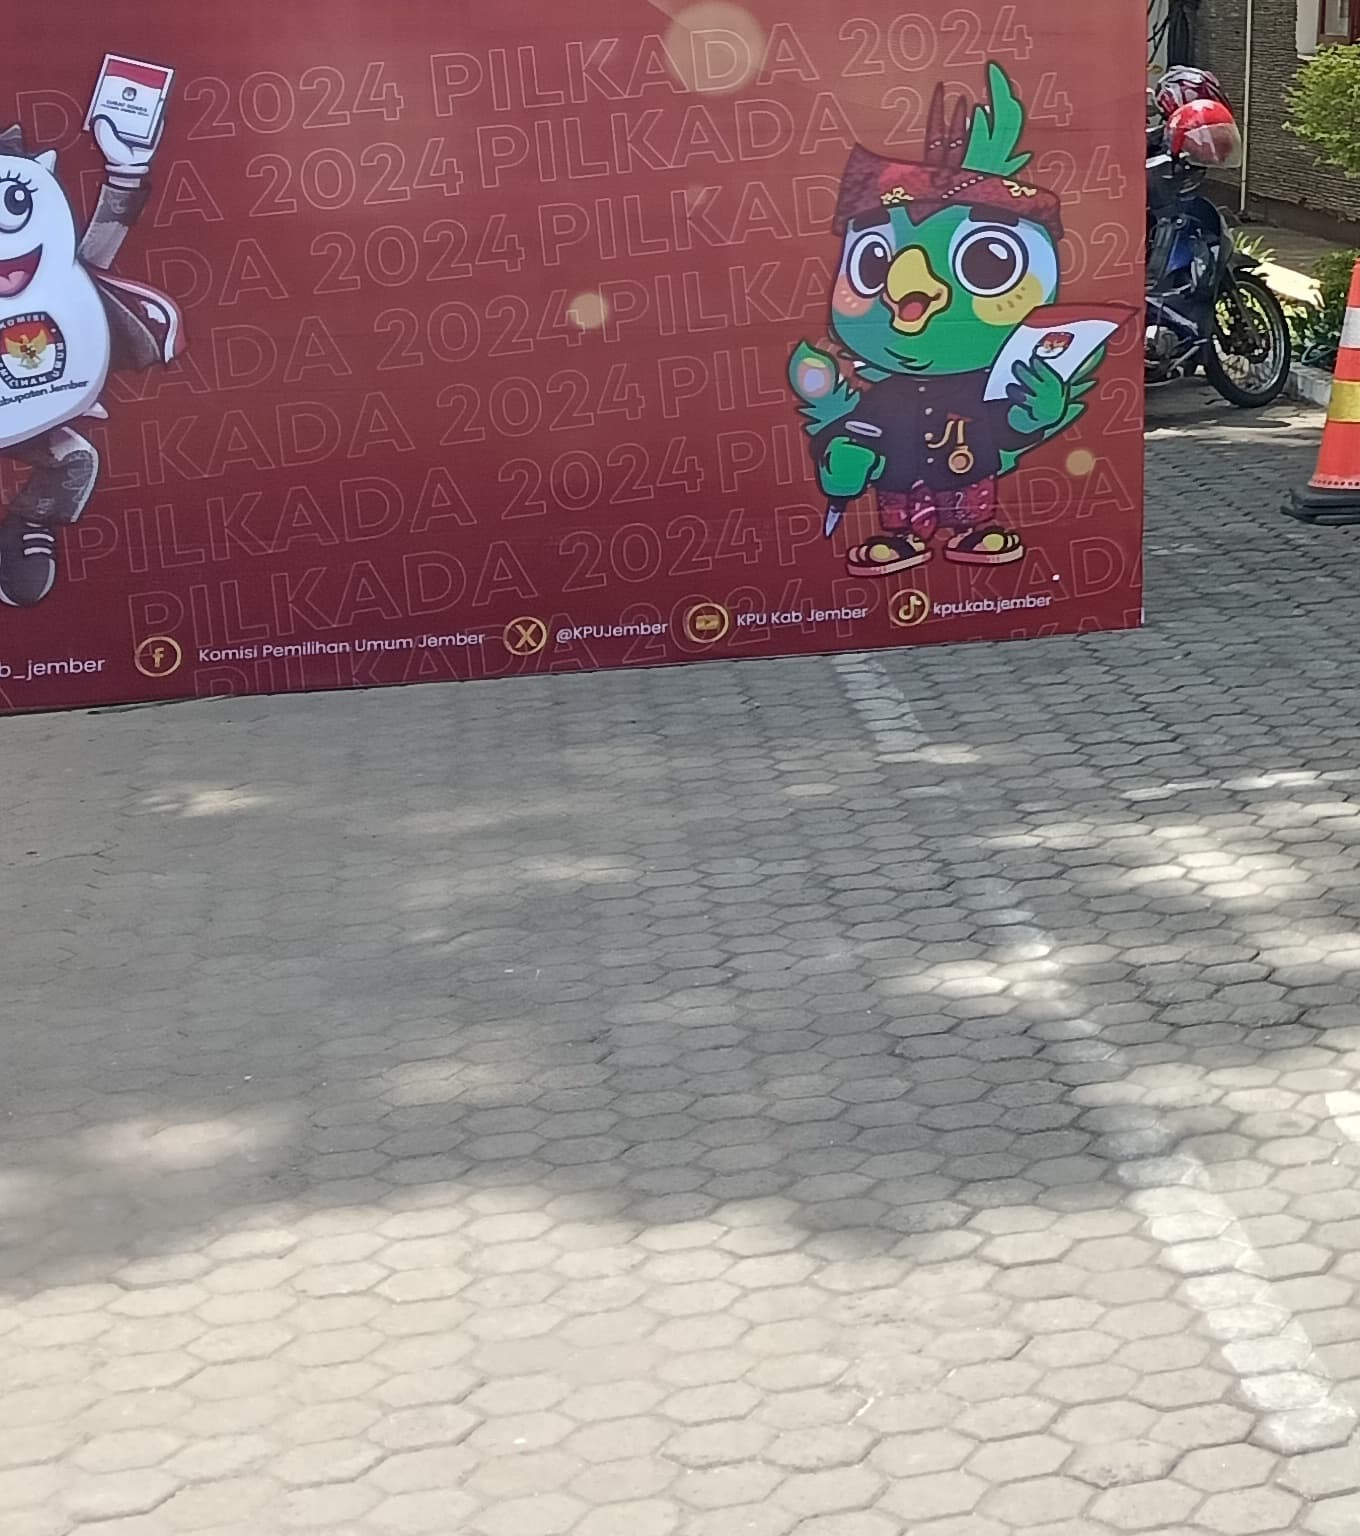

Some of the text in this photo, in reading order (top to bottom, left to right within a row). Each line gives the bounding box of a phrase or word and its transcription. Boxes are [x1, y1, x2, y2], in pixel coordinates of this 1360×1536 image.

[183, 5, 1034, 141] 2024 PILKADA 2024
[246, 137, 464, 218] 2024
[476, 91, 857, 190] PILKADA
[310, 213, 526, 296] 2024
[373, 289, 586, 371] 2024
[436, 362, 646, 446] 2024
[62, 466, 478, 583] PILKADA
[498, 436, 704, 520] 2024
[128, 540, 539, 656] PILKADA
[559, 508, 763, 592] 2024
[736, 606, 869, 626] KPU Kab Jember
[199, 632, 486, 663] Komisi Pemilihan Umum Jember
[555, 620, 668, 644] @KPUJember
